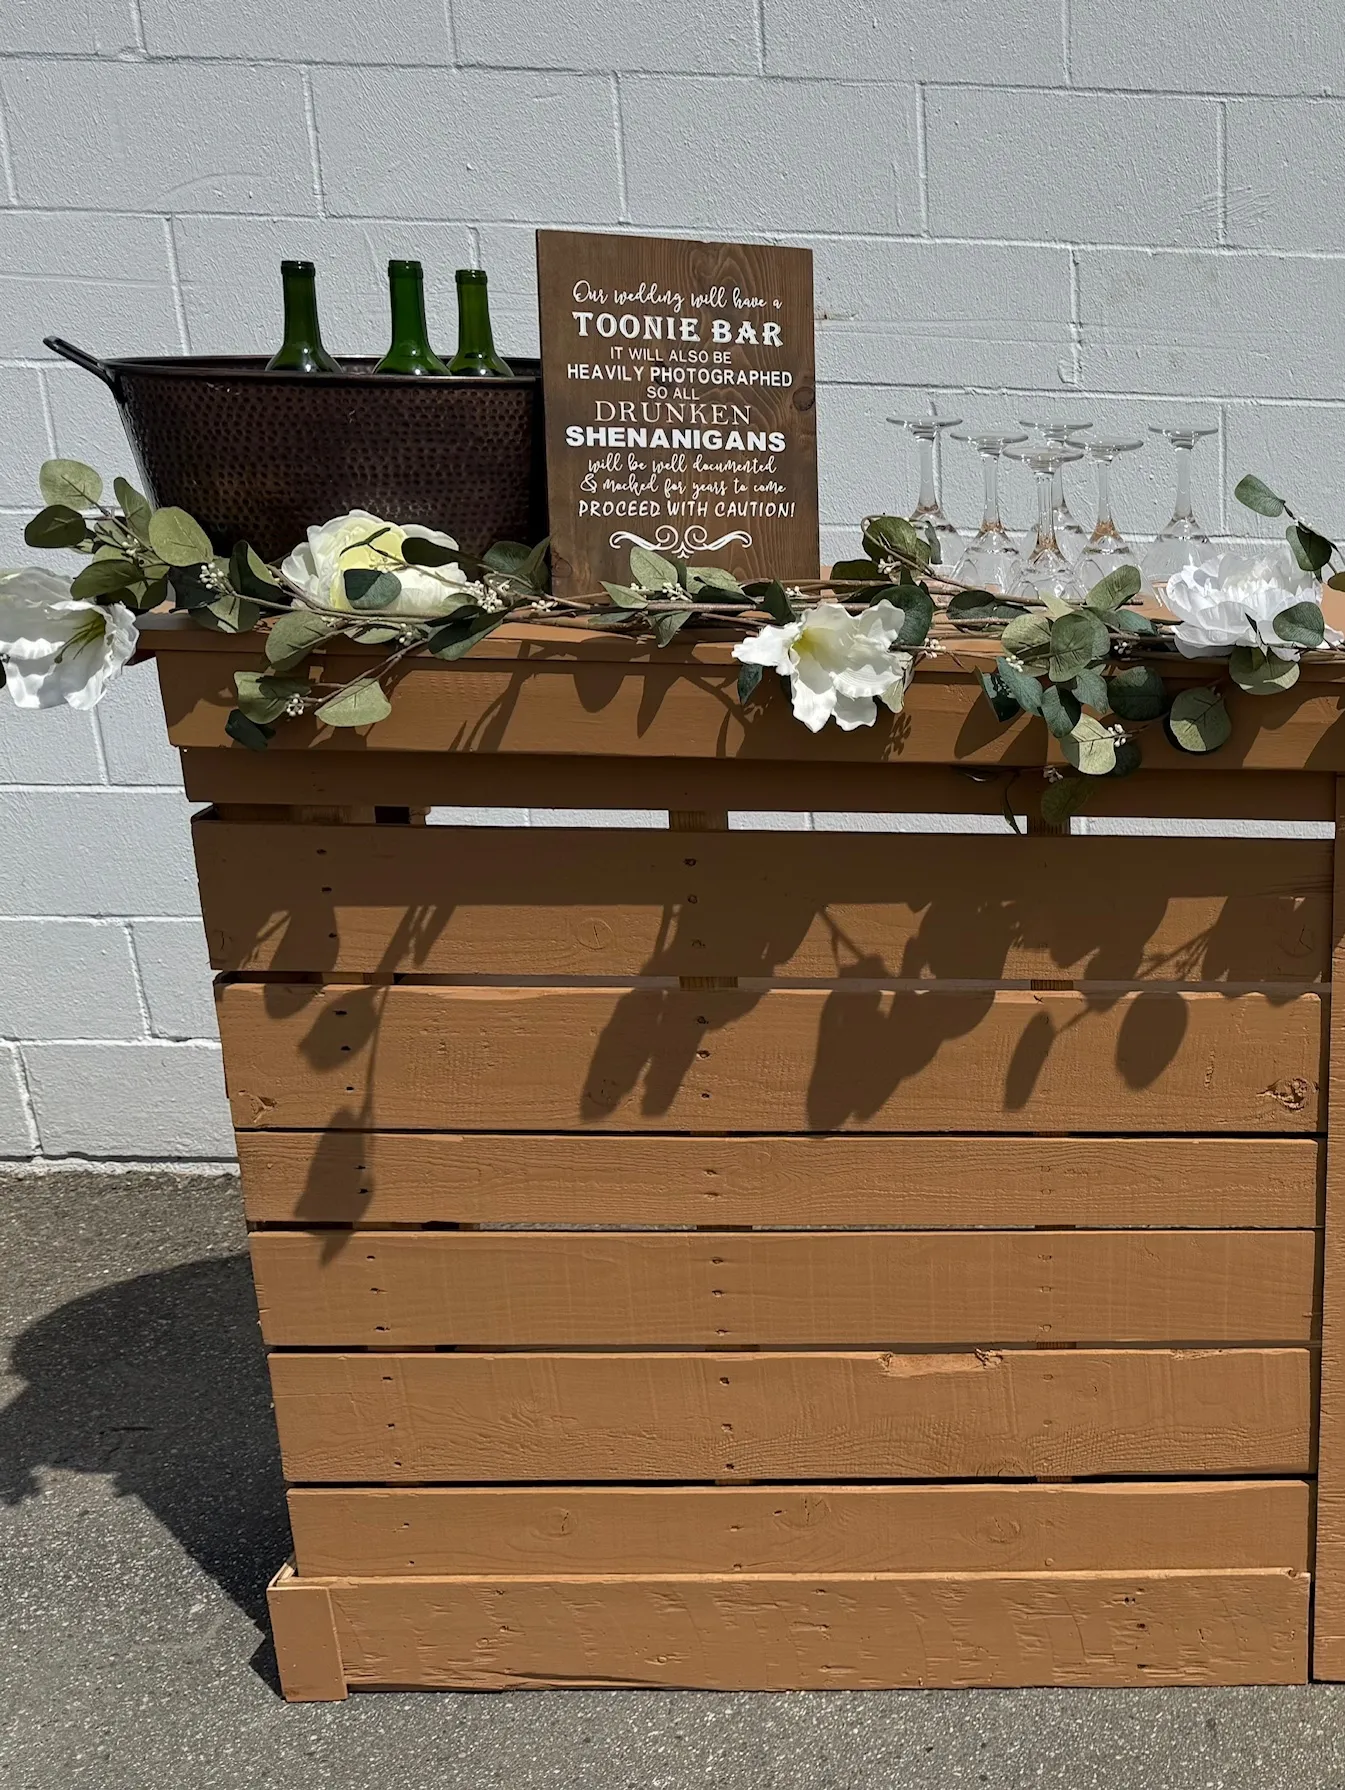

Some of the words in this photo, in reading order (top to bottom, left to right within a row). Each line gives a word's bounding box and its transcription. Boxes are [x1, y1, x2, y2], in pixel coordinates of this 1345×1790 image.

[572, 280, 608, 303] Our
[614, 283, 684, 313] wedding
[691, 286, 727, 308] will
[733, 288, 766, 308] have
[773, 299, 782, 309] a
[572, 312, 700, 342] TOONIE
[712, 320, 783, 347] BAR
[610, 347, 623, 359] IT
[629, 349, 663, 362] WILL
[669, 350, 708, 363] ALSO
[714, 352, 731, 364] BE
[568, 364, 644, 382] HEAVILY
[651, 366, 792, 387] PHOTOGRAPHED
[647, 386, 667, 399] SO
[673, 387, 699, 400] ALL
[595, 401, 751, 425] DRUNKEN
[566, 426, 786, 452] SHENANIGANS
[589, 453, 623, 473] will
[628, 453, 646, 471] be
[652, 454, 687, 473] well
[693, 456, 776, 474] documented
[580, 473, 598, 493] &
[603, 474, 658, 496] mocked
[665, 479, 686, 497] for
[693, 481, 728, 500] years
[733, 479, 747, 492] to
[753, 484, 786, 493] come
[579, 500, 661, 517] PROCEED
[667, 502, 708, 517] WITH
[715, 502, 796, 517] CAUTION!
